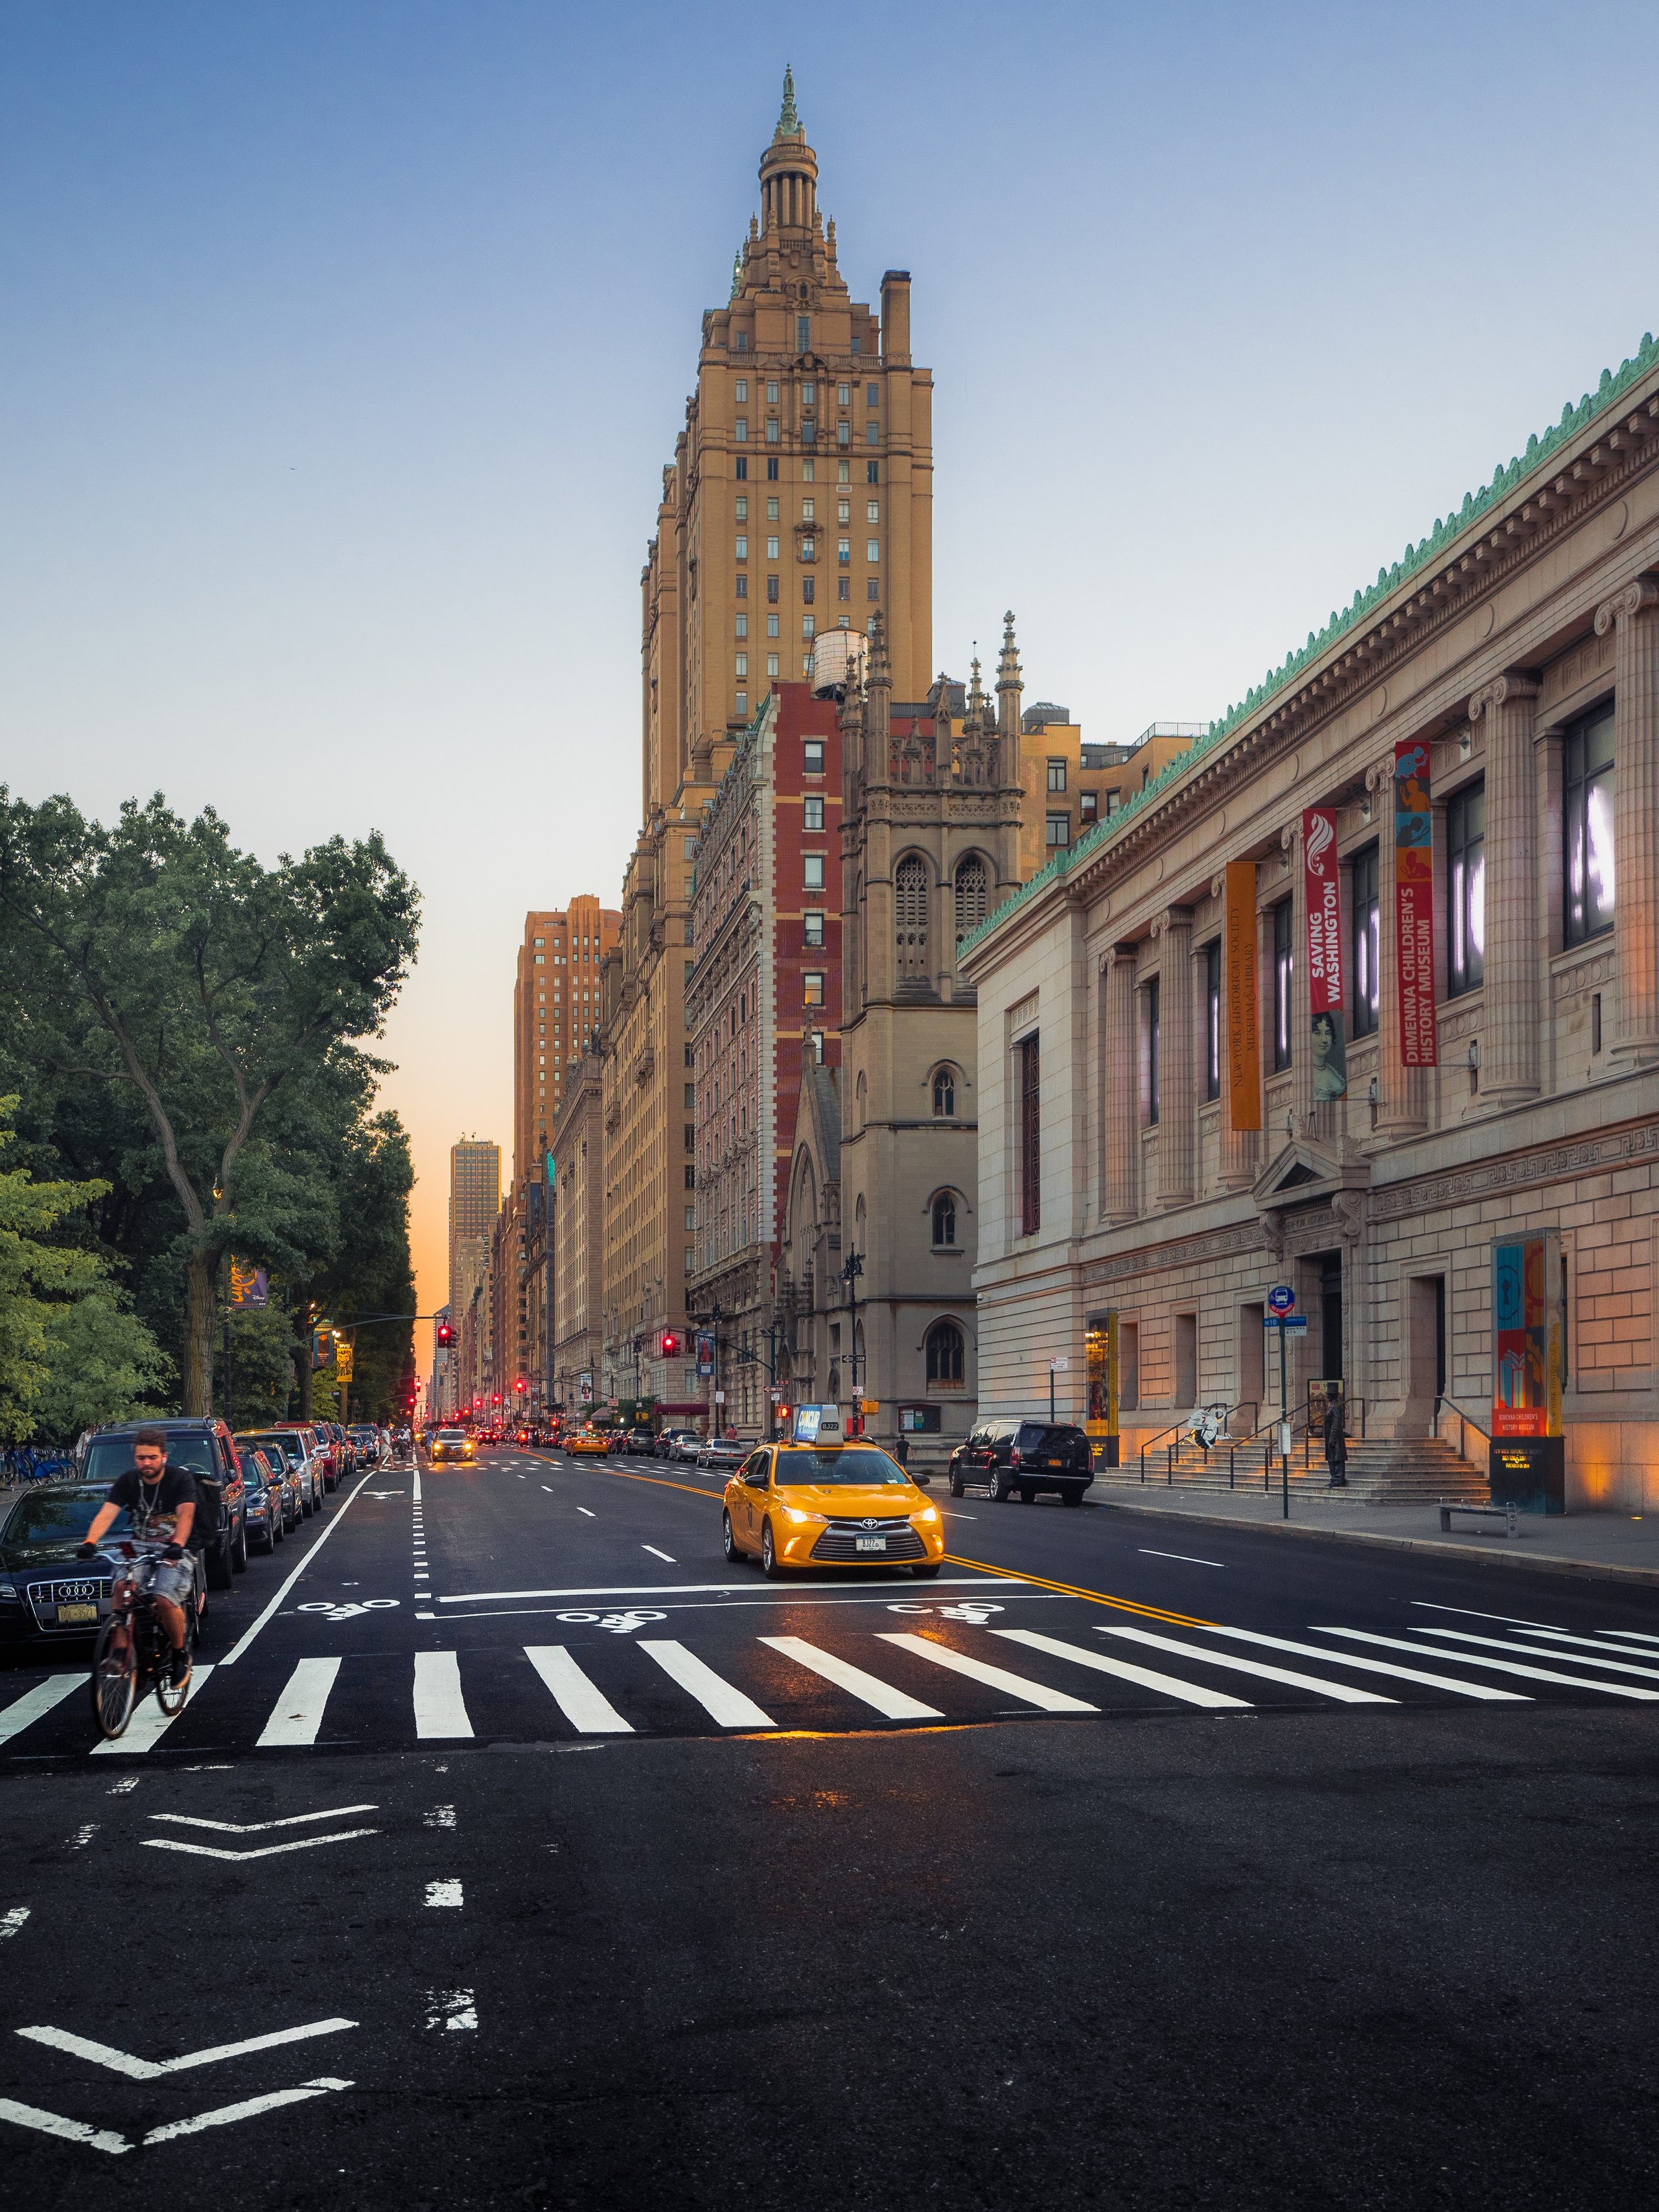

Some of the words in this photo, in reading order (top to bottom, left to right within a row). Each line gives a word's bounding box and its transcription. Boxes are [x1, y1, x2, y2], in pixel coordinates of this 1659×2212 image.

[1231, 907, 1240, 953] SOCIETY
[1310, 912, 1324, 978] SAVING
[1323, 882, 1340, 1003] WASHINGTON
[1417, 919, 1431, 992] MUSEUM
[1231, 958, 1242, 1025] HISTORICAL
[1244, 942, 1254, 989] LIBRARY
[1246, 1003, 1256, 1051] MUSEUM
[1404, 985, 1418, 1062] DIMENNA
[1419, 997, 1433, 1063] HISTORY
[1233, 1029, 1243, 1088] NEW-YORK
